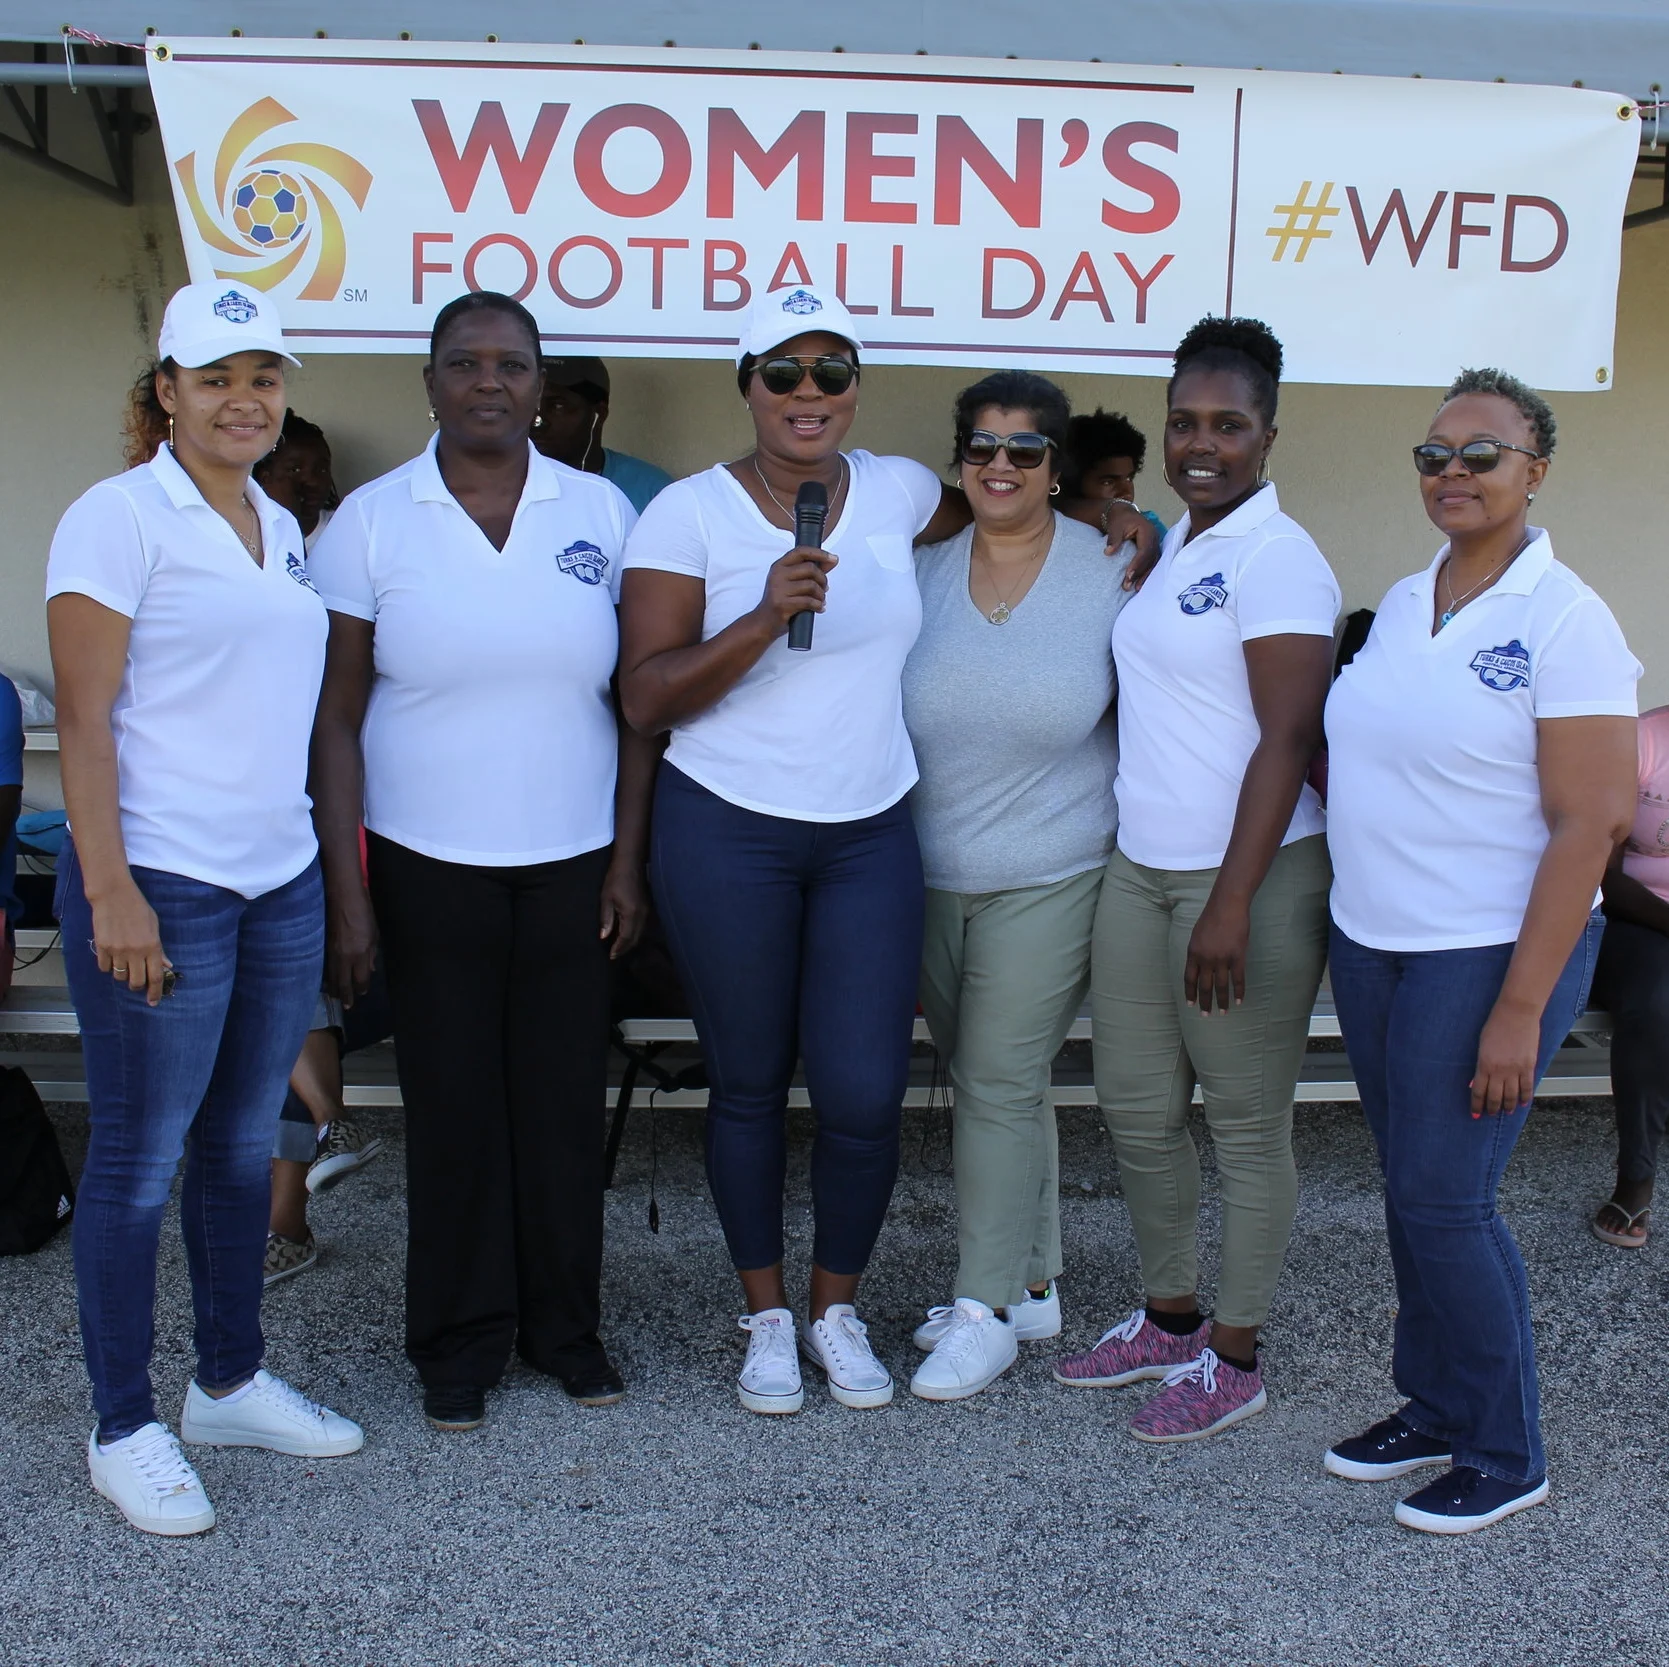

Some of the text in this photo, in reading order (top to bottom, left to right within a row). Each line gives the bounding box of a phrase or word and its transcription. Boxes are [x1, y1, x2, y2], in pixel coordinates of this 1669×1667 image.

[412, 98, 1181, 234] WOMEN’S
[1265, 180, 1569, 273] #WFD
[344, 288, 368, 302] SM
[412, 232, 1175, 324] FOOTBALL DAY
[1479, 653, 1495, 662] TURKS
